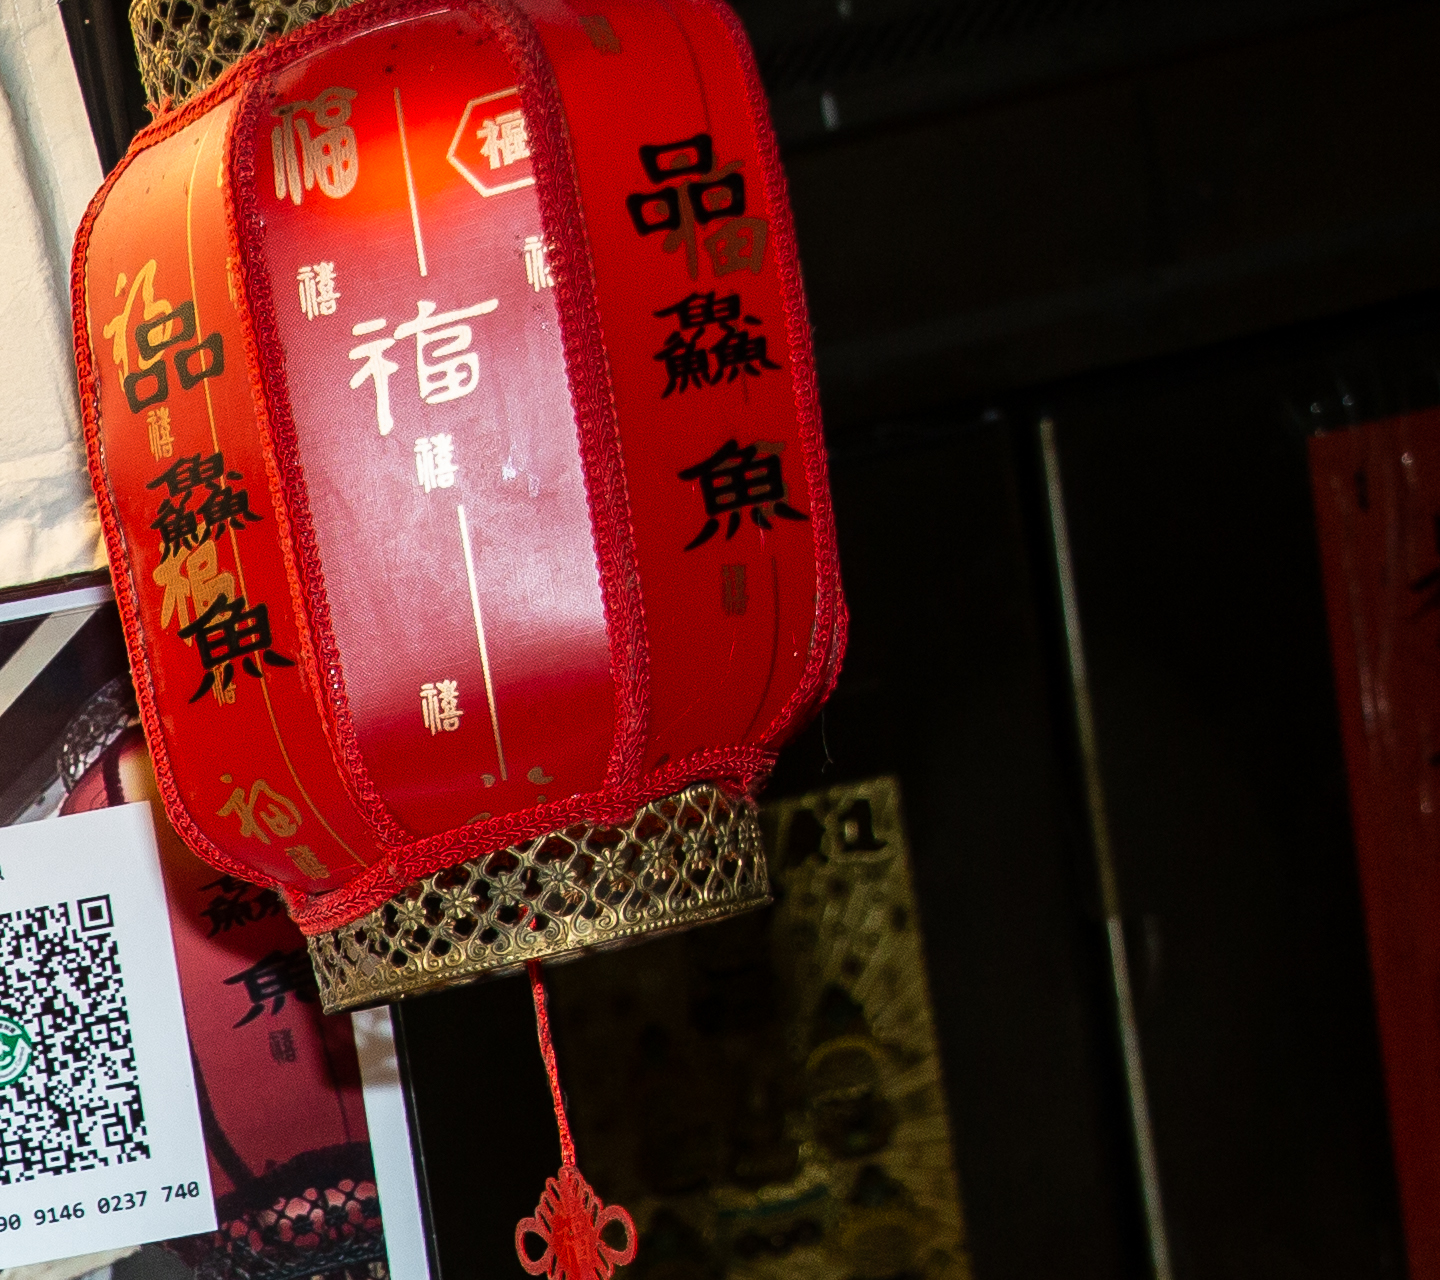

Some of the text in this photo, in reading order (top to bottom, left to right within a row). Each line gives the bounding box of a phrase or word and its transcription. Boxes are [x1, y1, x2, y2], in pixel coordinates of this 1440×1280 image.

[348, 300, 499, 436] 福
[33, 1203, 85, 1226] 9146
[97, 1191, 148, 1215] 0237
[161, 1181, 200, 1202] 740
